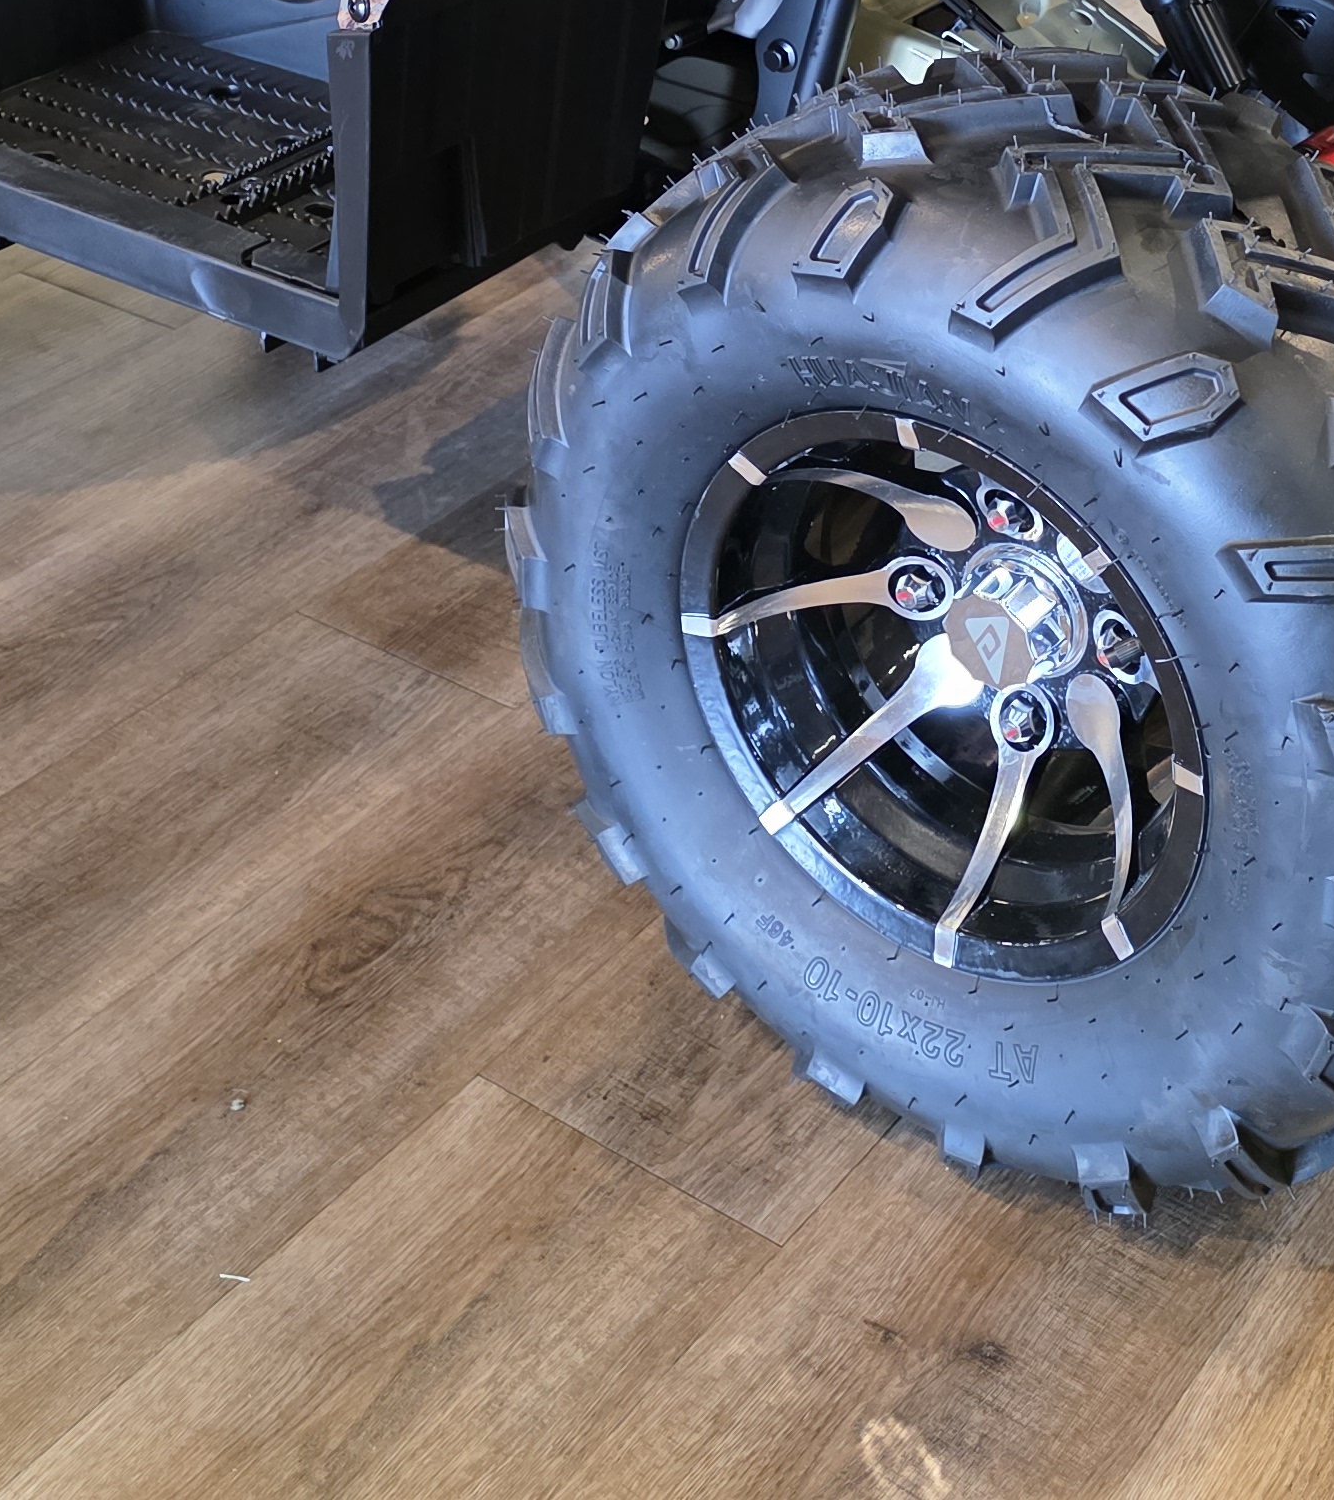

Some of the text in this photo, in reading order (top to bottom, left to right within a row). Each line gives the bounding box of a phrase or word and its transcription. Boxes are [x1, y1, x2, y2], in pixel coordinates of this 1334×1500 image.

[591, 577, 610, 652] TUBELESS
[754, 912, 795, 949] 46F
[803, 954, 967, 1069] 22x10-10
[987, 1040, 1039, 1085] AT
